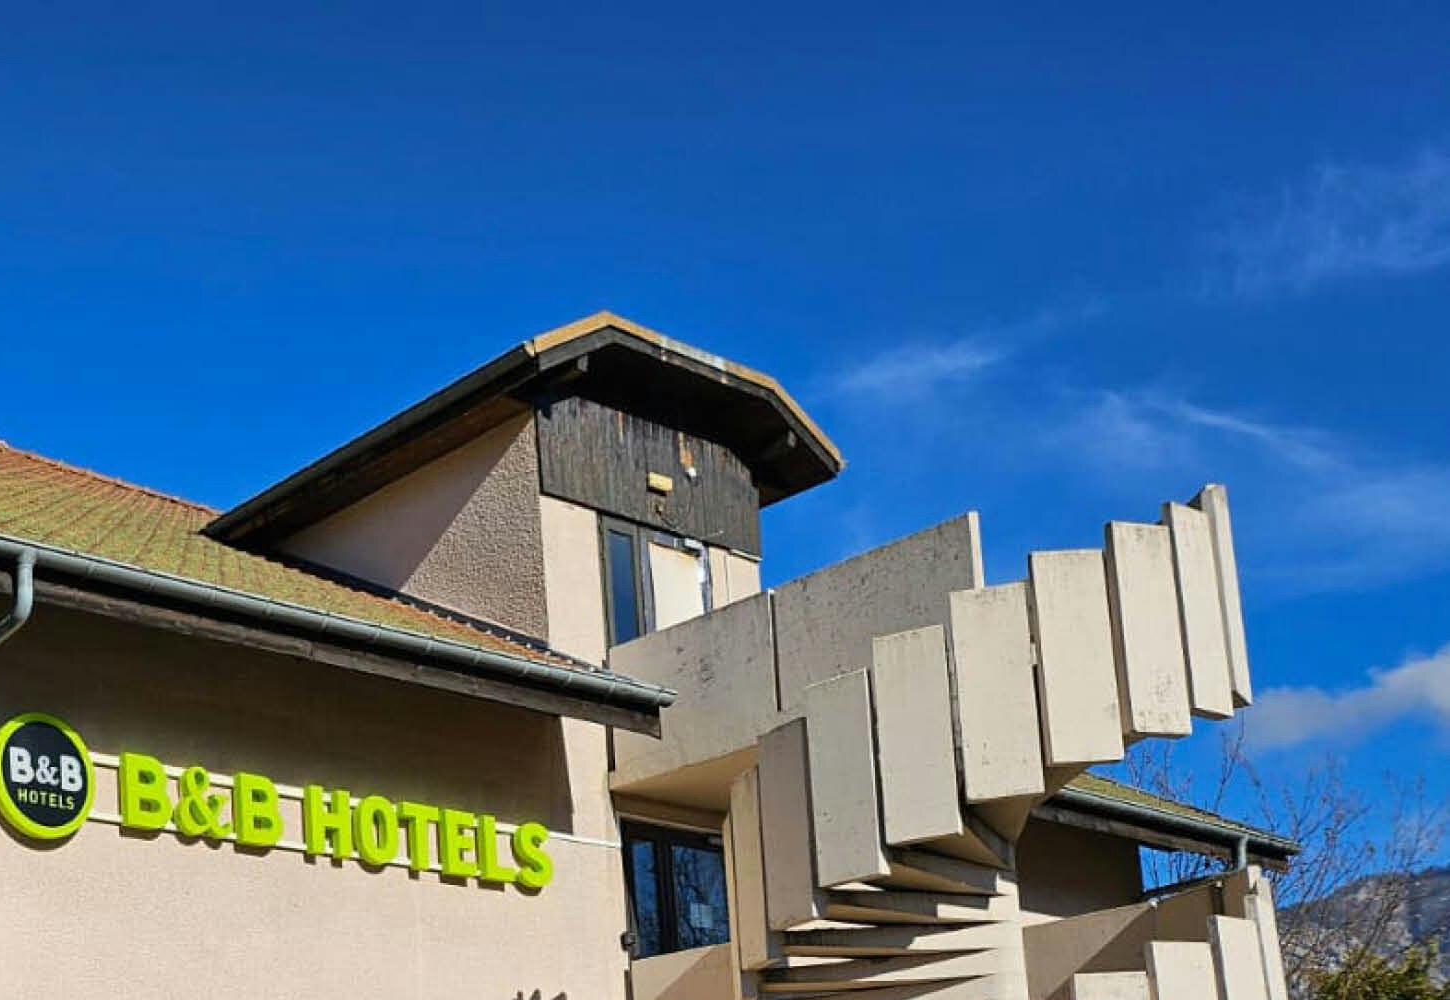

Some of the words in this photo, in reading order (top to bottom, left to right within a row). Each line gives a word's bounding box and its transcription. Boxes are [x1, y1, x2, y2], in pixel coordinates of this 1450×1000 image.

[9, 746, 83, 792] B&B
[17, 788, 75, 810] HOTELS
[118, 751, 284, 847] B&B
[303, 783, 554, 887] HOTELS
